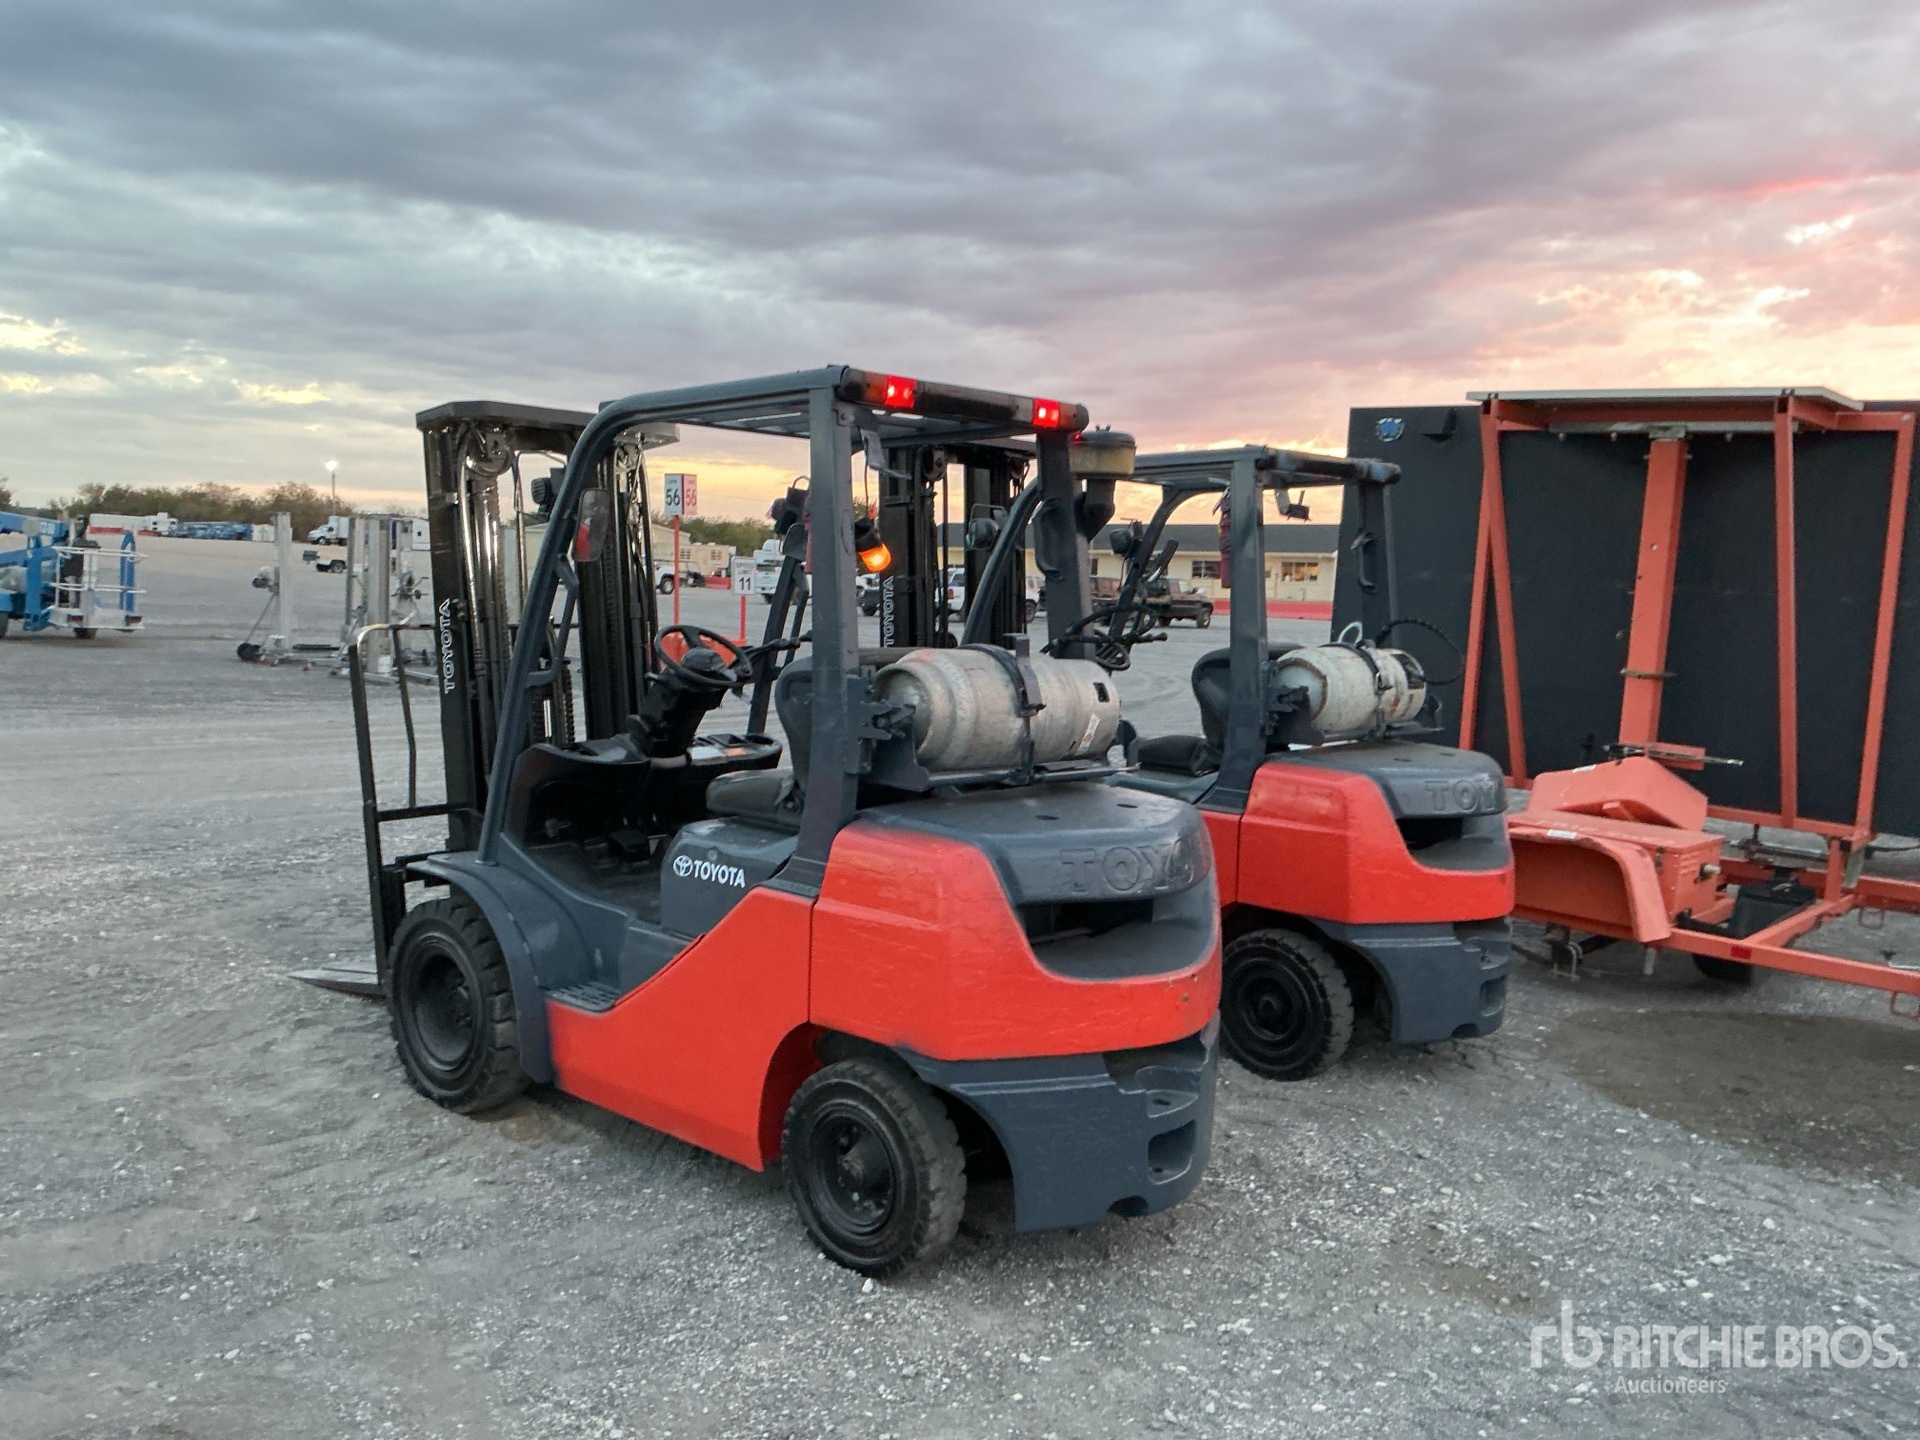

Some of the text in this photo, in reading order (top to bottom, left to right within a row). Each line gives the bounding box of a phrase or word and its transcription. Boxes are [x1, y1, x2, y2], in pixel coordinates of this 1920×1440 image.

[666, 488, 681, 506] 56
[686, 488, 697, 507] 56
[739, 577, 751, 591] 11
[883, 575, 895, 648] TOYOTA
[439, 598, 455, 694] TOYOTA
[1424, 779, 1498, 812] TOY
[694, 859, 746, 888] TOYOTA
